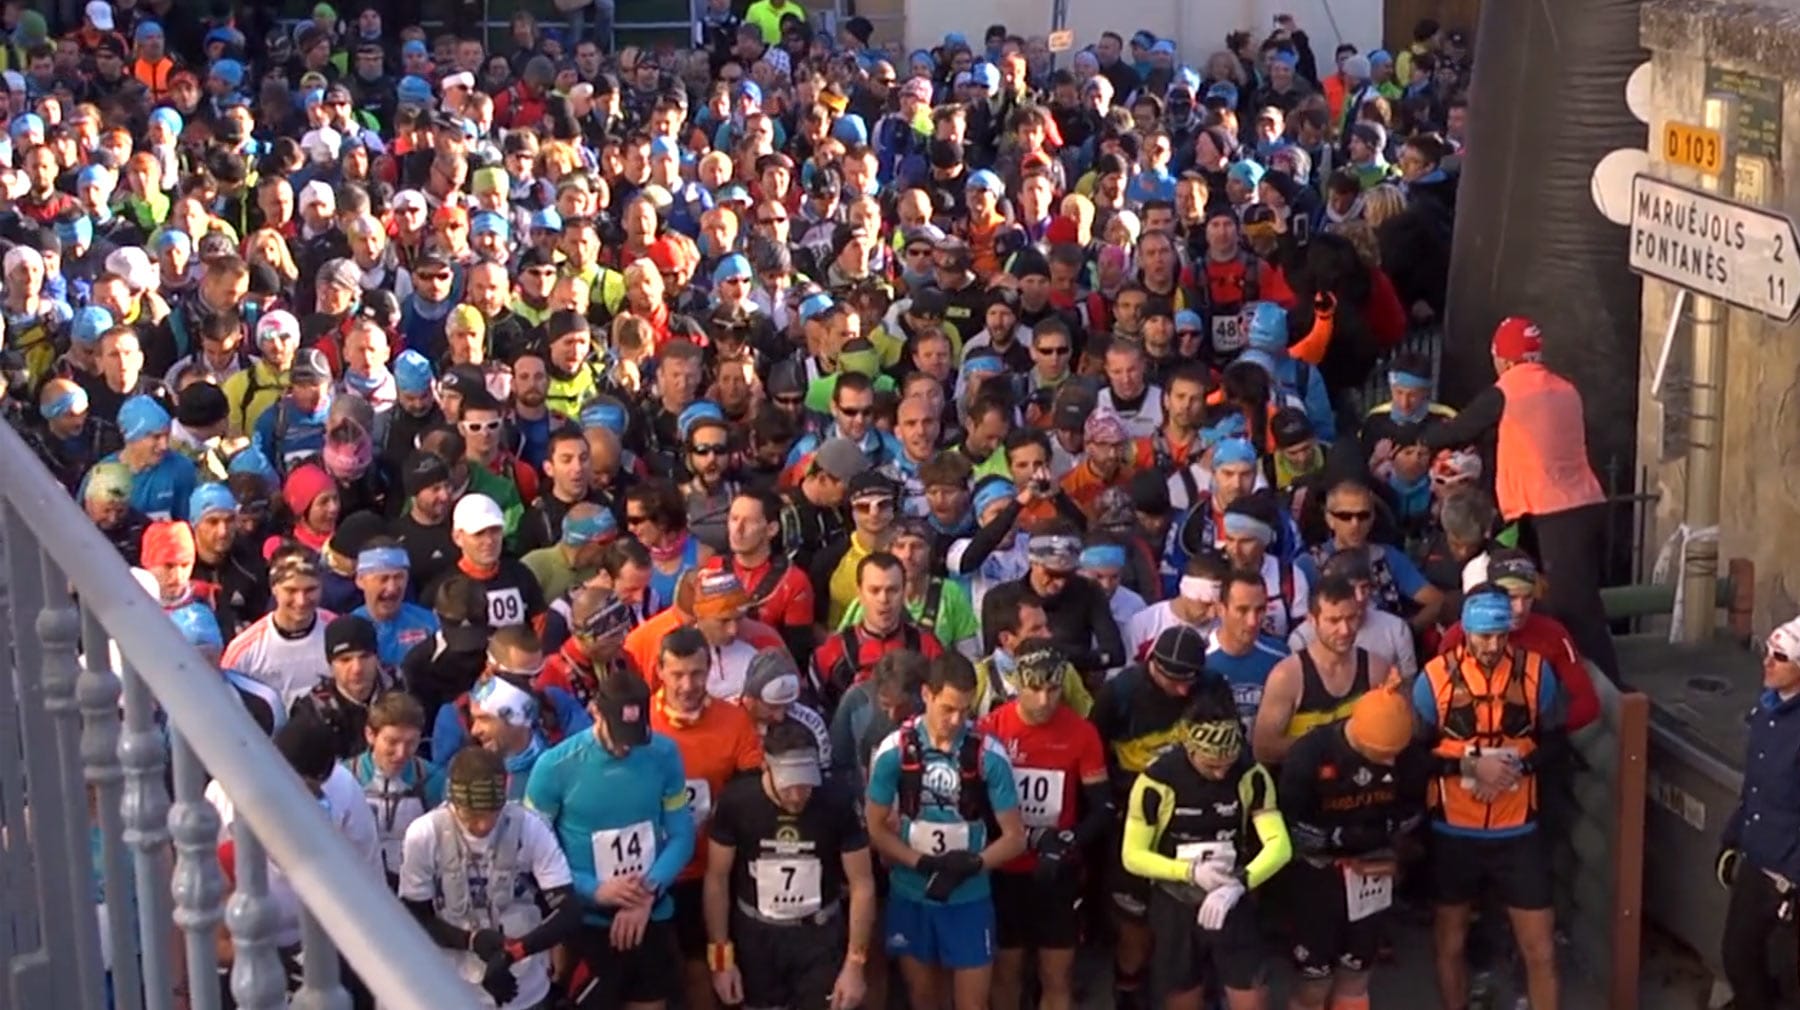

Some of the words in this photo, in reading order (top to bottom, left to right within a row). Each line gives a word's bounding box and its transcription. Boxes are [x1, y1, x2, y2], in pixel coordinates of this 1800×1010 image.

[1668, 129, 1679, 157] D
[1685, 133, 1716, 168] 103
[1638, 191, 1746, 250] MARUÉJOLS
[1772, 233, 1784, 264] 2
[1635, 229, 1728, 284] FONTANÈS
[1767, 274, 1786, 306] 11
[492, 594, 519, 621] 09
[1018, 775, 1050, 802] 10
[610, 831, 643, 863] 14
[931, 829, 946, 855] 3
[780, 866, 797, 892] 7
